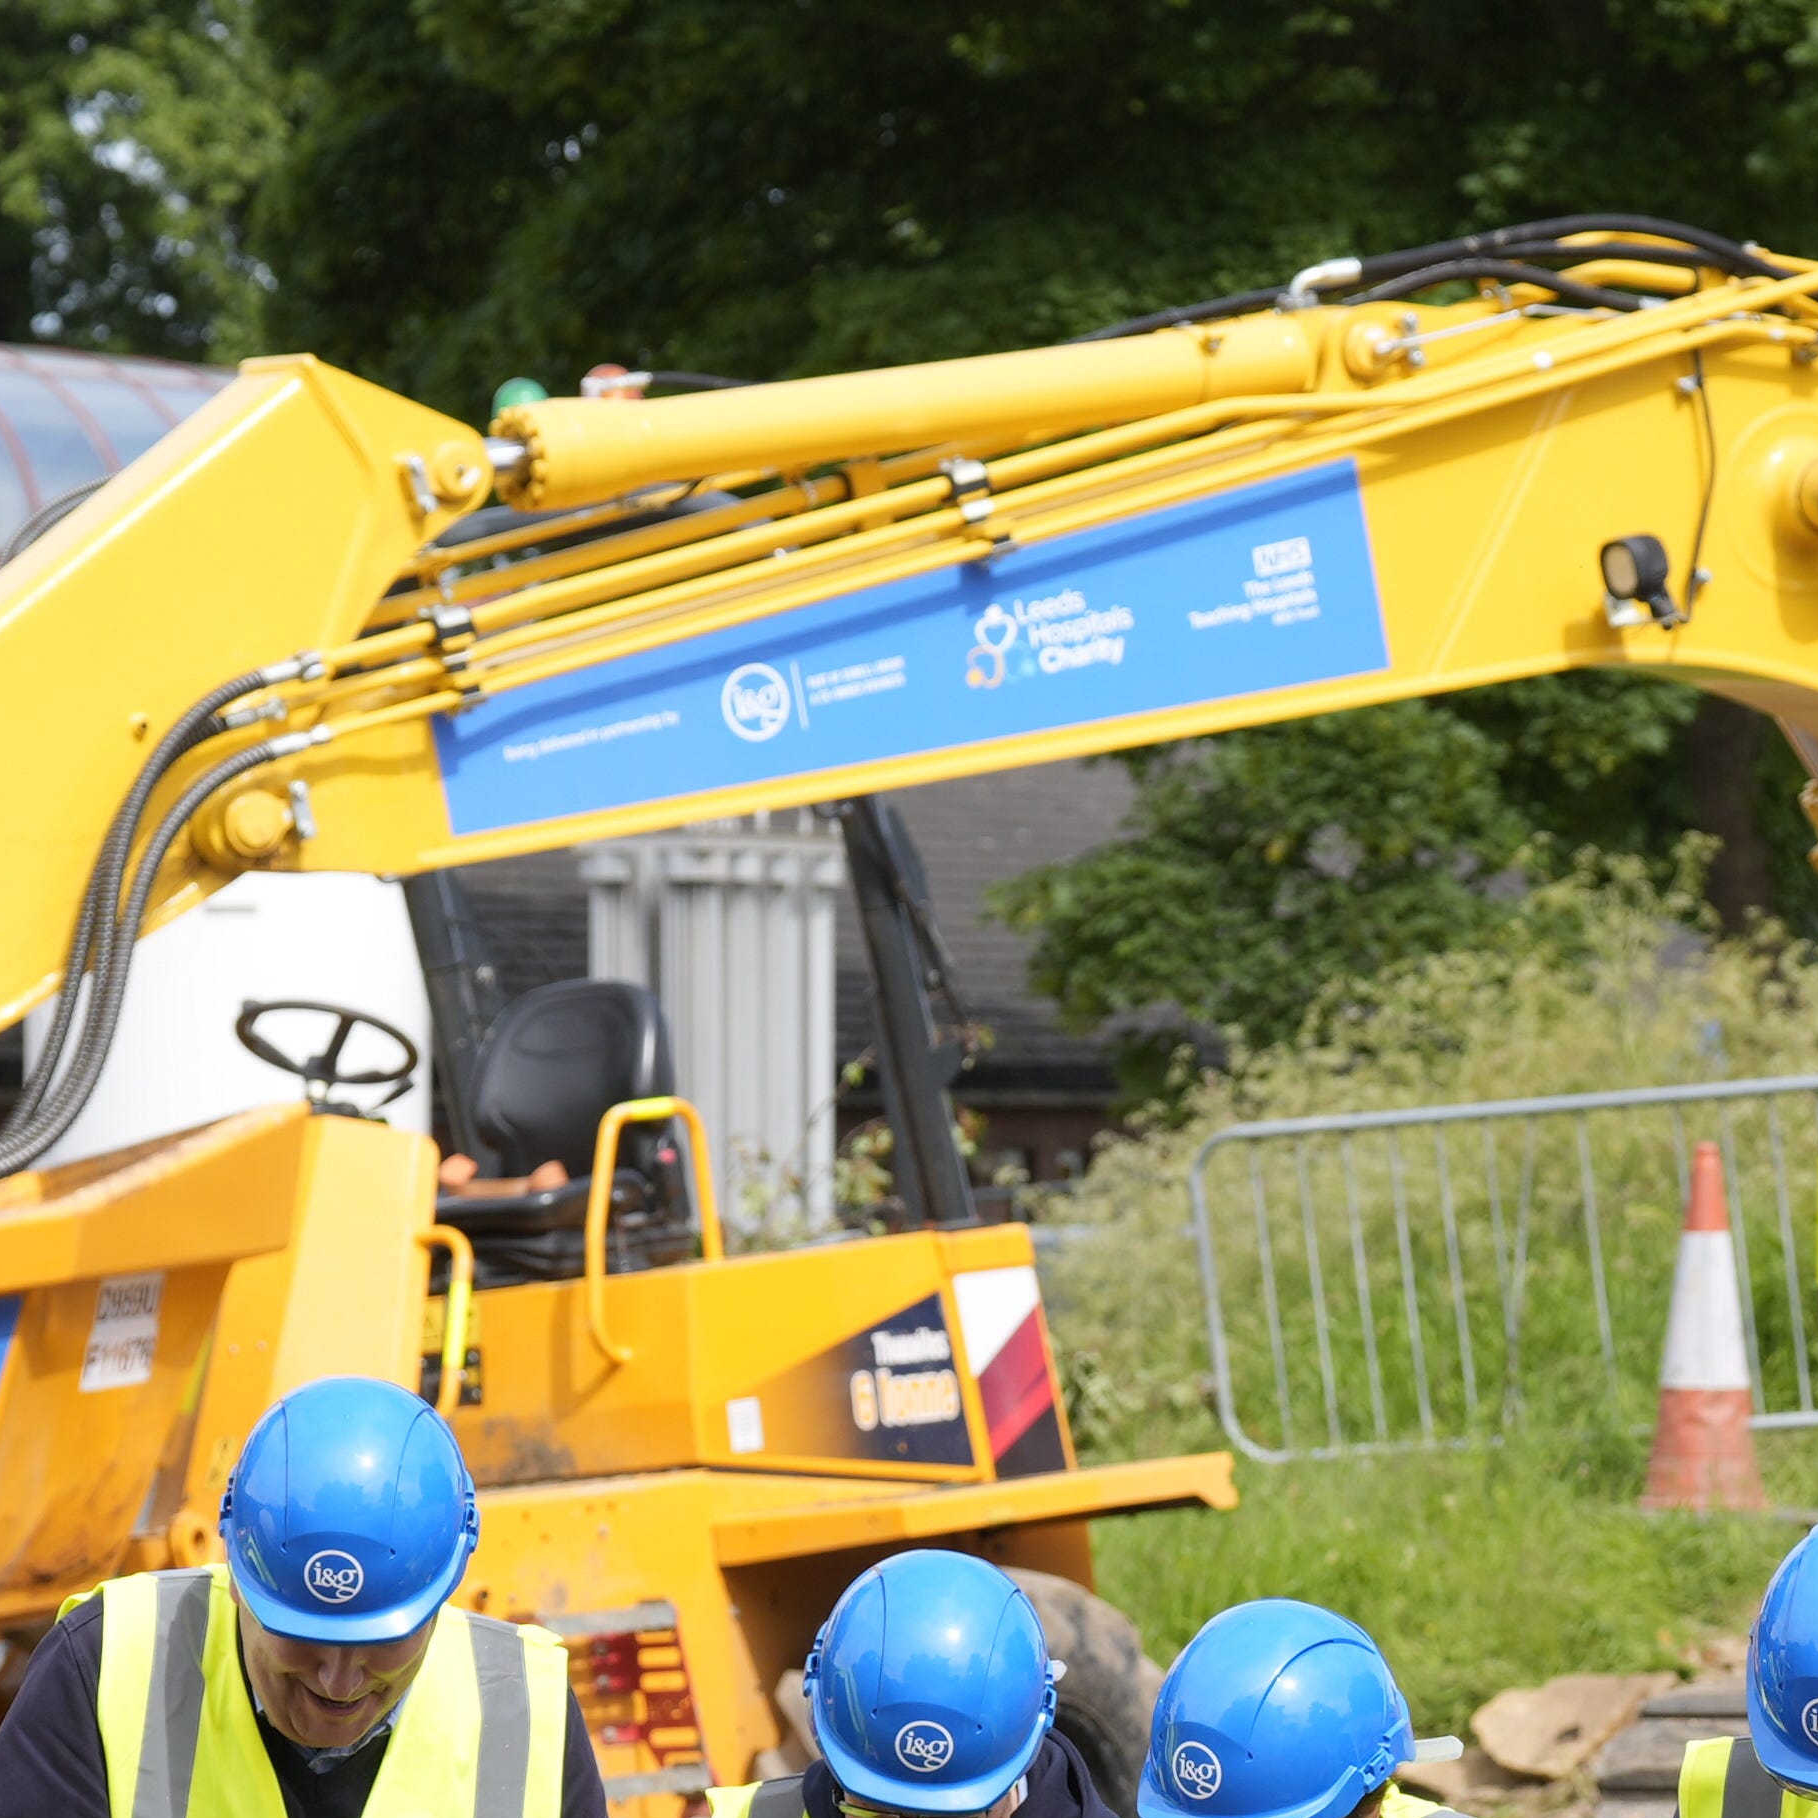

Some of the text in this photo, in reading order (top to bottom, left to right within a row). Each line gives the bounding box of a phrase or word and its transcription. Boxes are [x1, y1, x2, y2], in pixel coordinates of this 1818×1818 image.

[1013, 588, 1086, 625] Leeds
[1028, 605, 1134, 648] Hospitals
[1038, 635, 1124, 674] Charity
[876, 1367, 960, 1428] tonne
[312, 1561, 357, 1600] i&g
[903, 1730, 948, 1769] i&g
[1178, 1752, 1216, 1796] i&g
